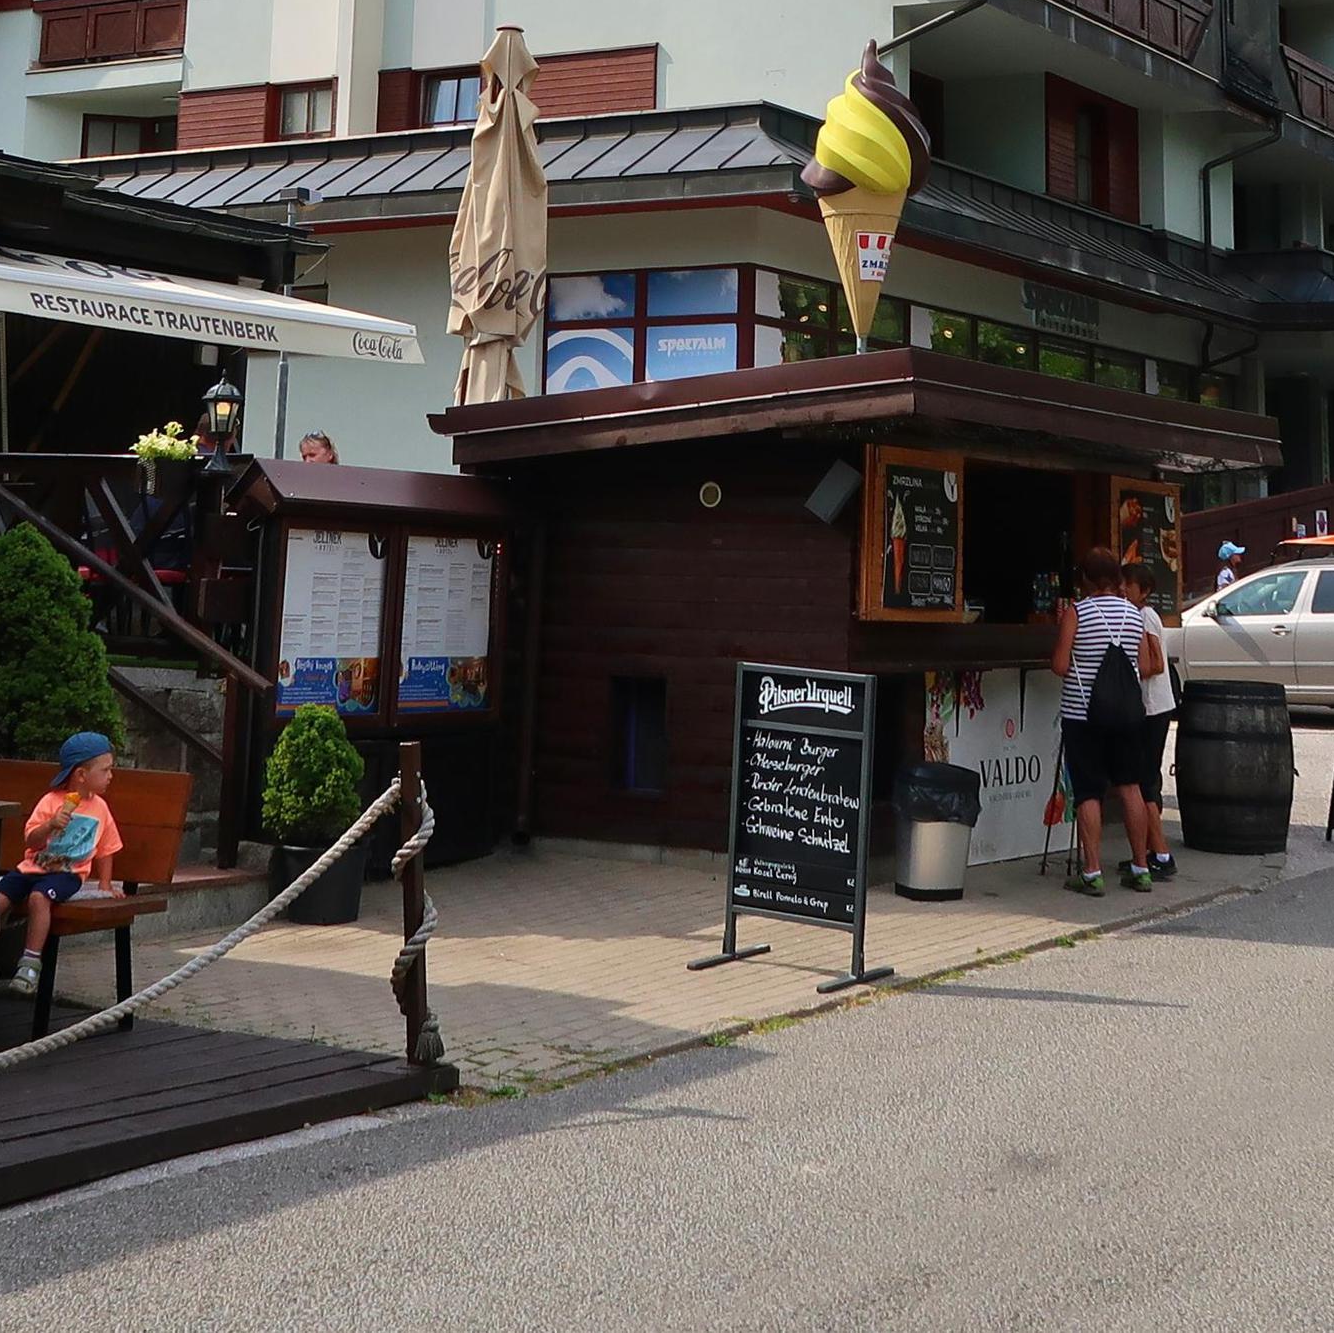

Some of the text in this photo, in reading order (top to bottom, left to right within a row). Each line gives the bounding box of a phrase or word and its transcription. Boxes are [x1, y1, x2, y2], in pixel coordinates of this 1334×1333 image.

[30, 291, 280, 344] RESTAURACE TRAUTENBERK
[352, 330, 404, 362] Coca-Cola
[758, 676, 809, 715] Pilsner
[800, 738, 840, 764] Burger
[980, 754, 1041, 788] VALDO
